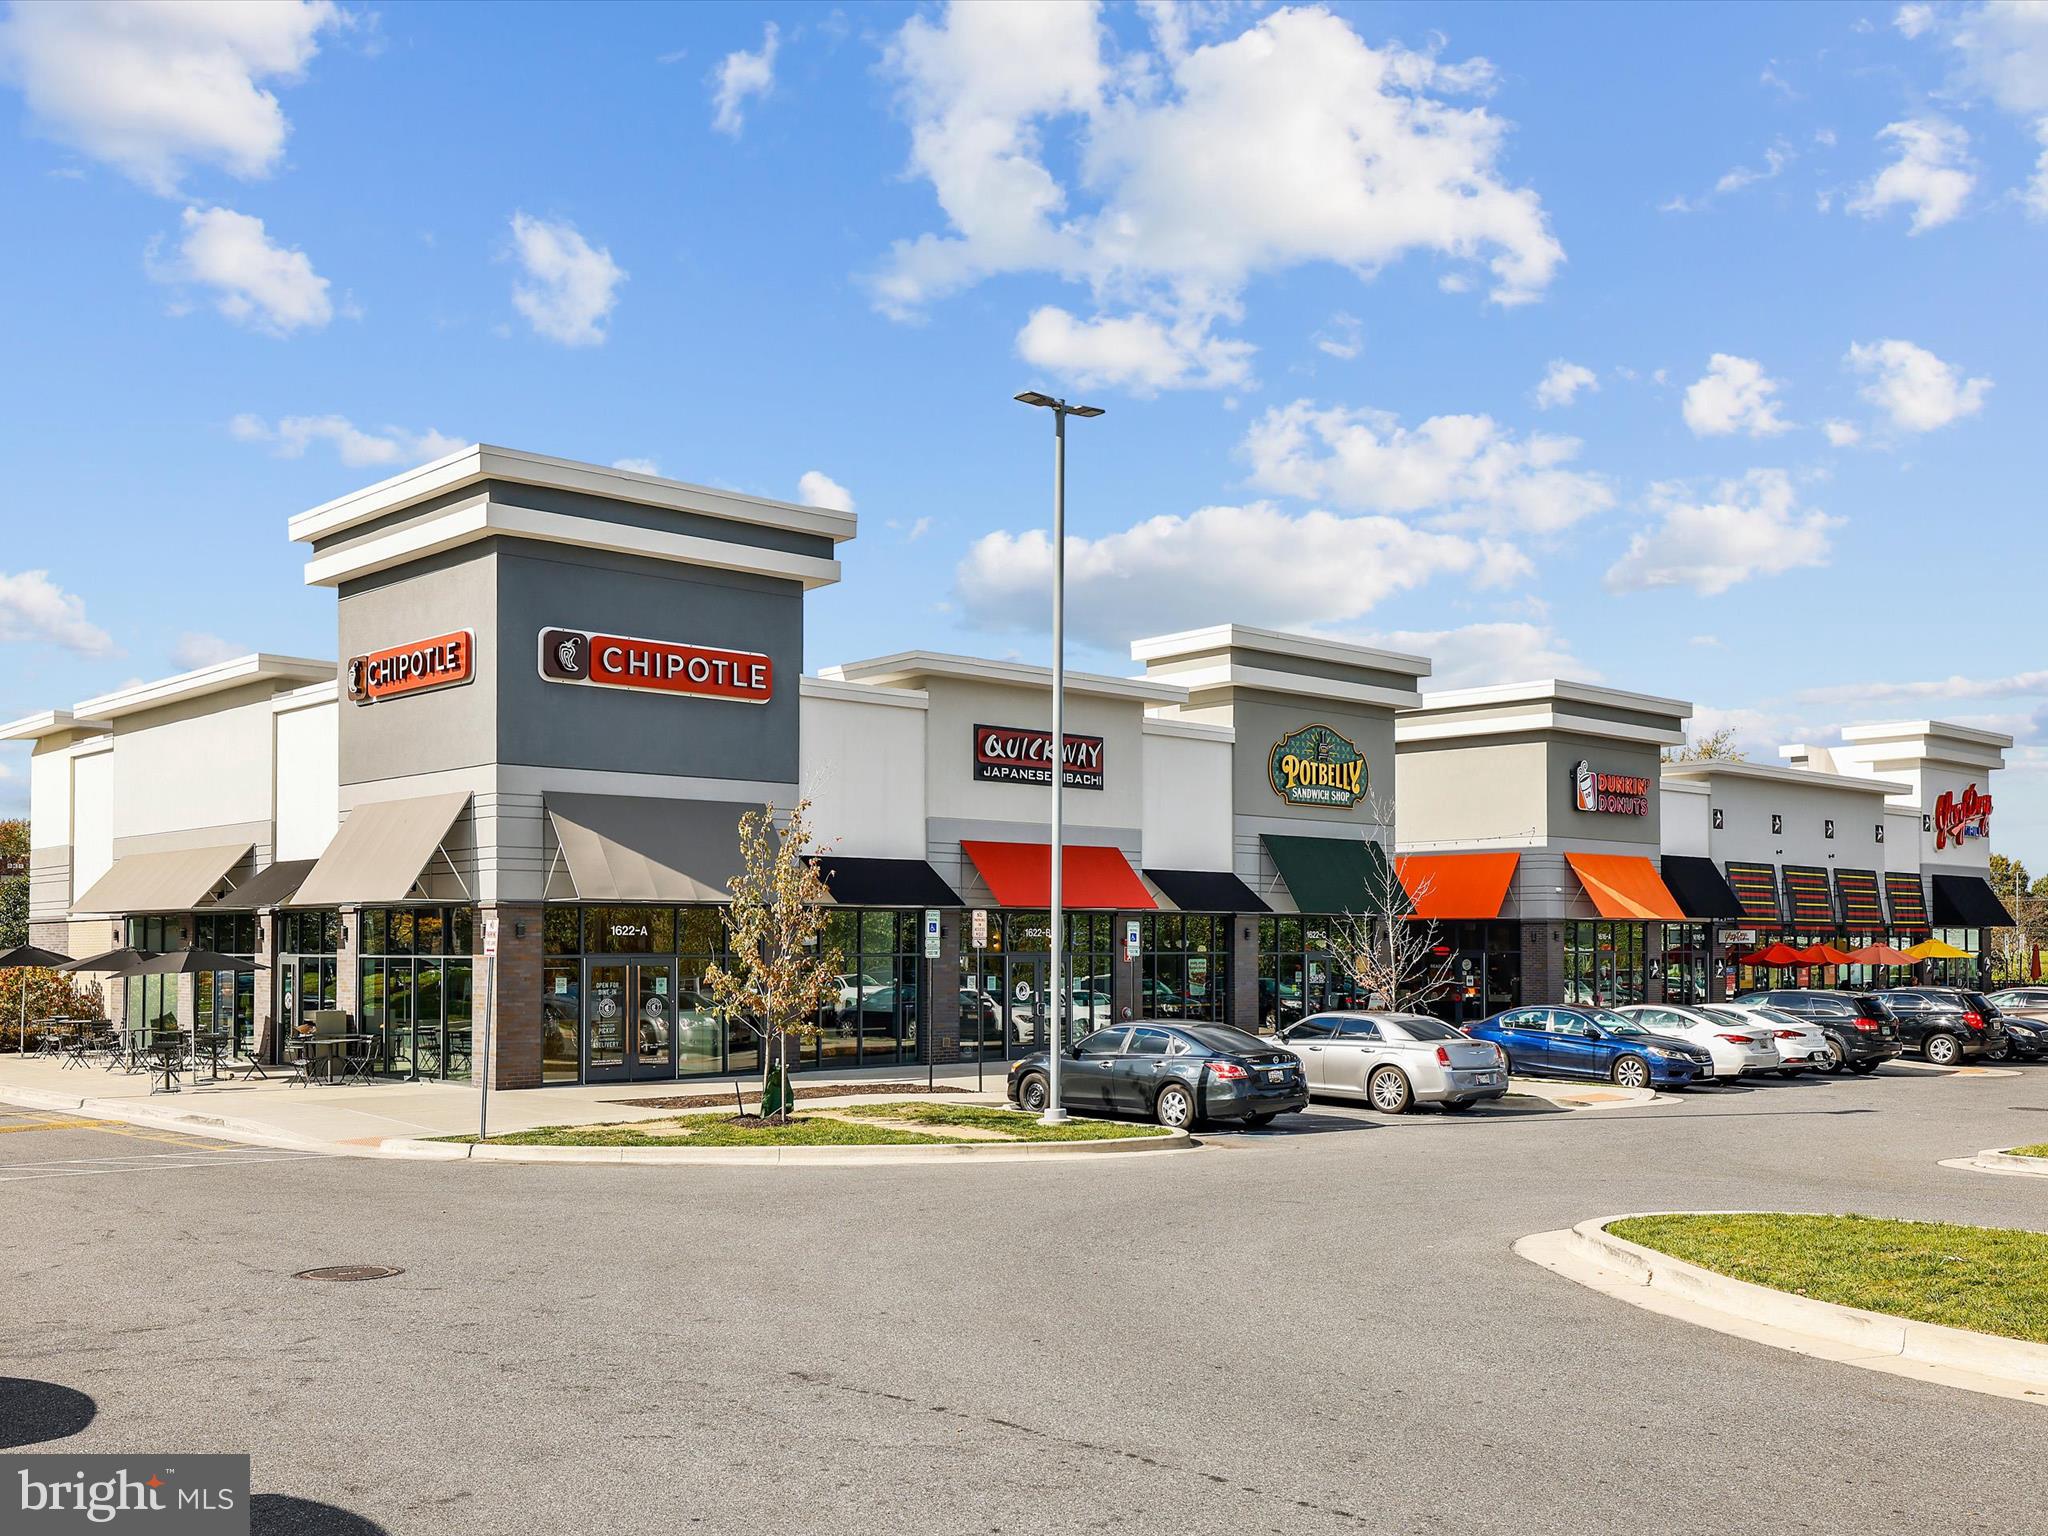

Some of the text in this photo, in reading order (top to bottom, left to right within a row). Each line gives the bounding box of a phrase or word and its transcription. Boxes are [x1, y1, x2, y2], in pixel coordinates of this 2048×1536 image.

[368, 641, 457, 686] CHIPOTLE
[602, 646, 767, 689] CHIPOTLE
[983, 766, 1102, 786] JAPANESE IBACHI
[1281, 754, 1364, 795] POTBELLY
[1292, 787, 1350, 802] SANDWICH SHOP
[1598, 794, 1649, 817] DONUTS
[610, 925, 648, 936] 1622-A
[1306, 930, 1327, 939] 1622-C
[598, 1027, 616, 1035] PICKUP
